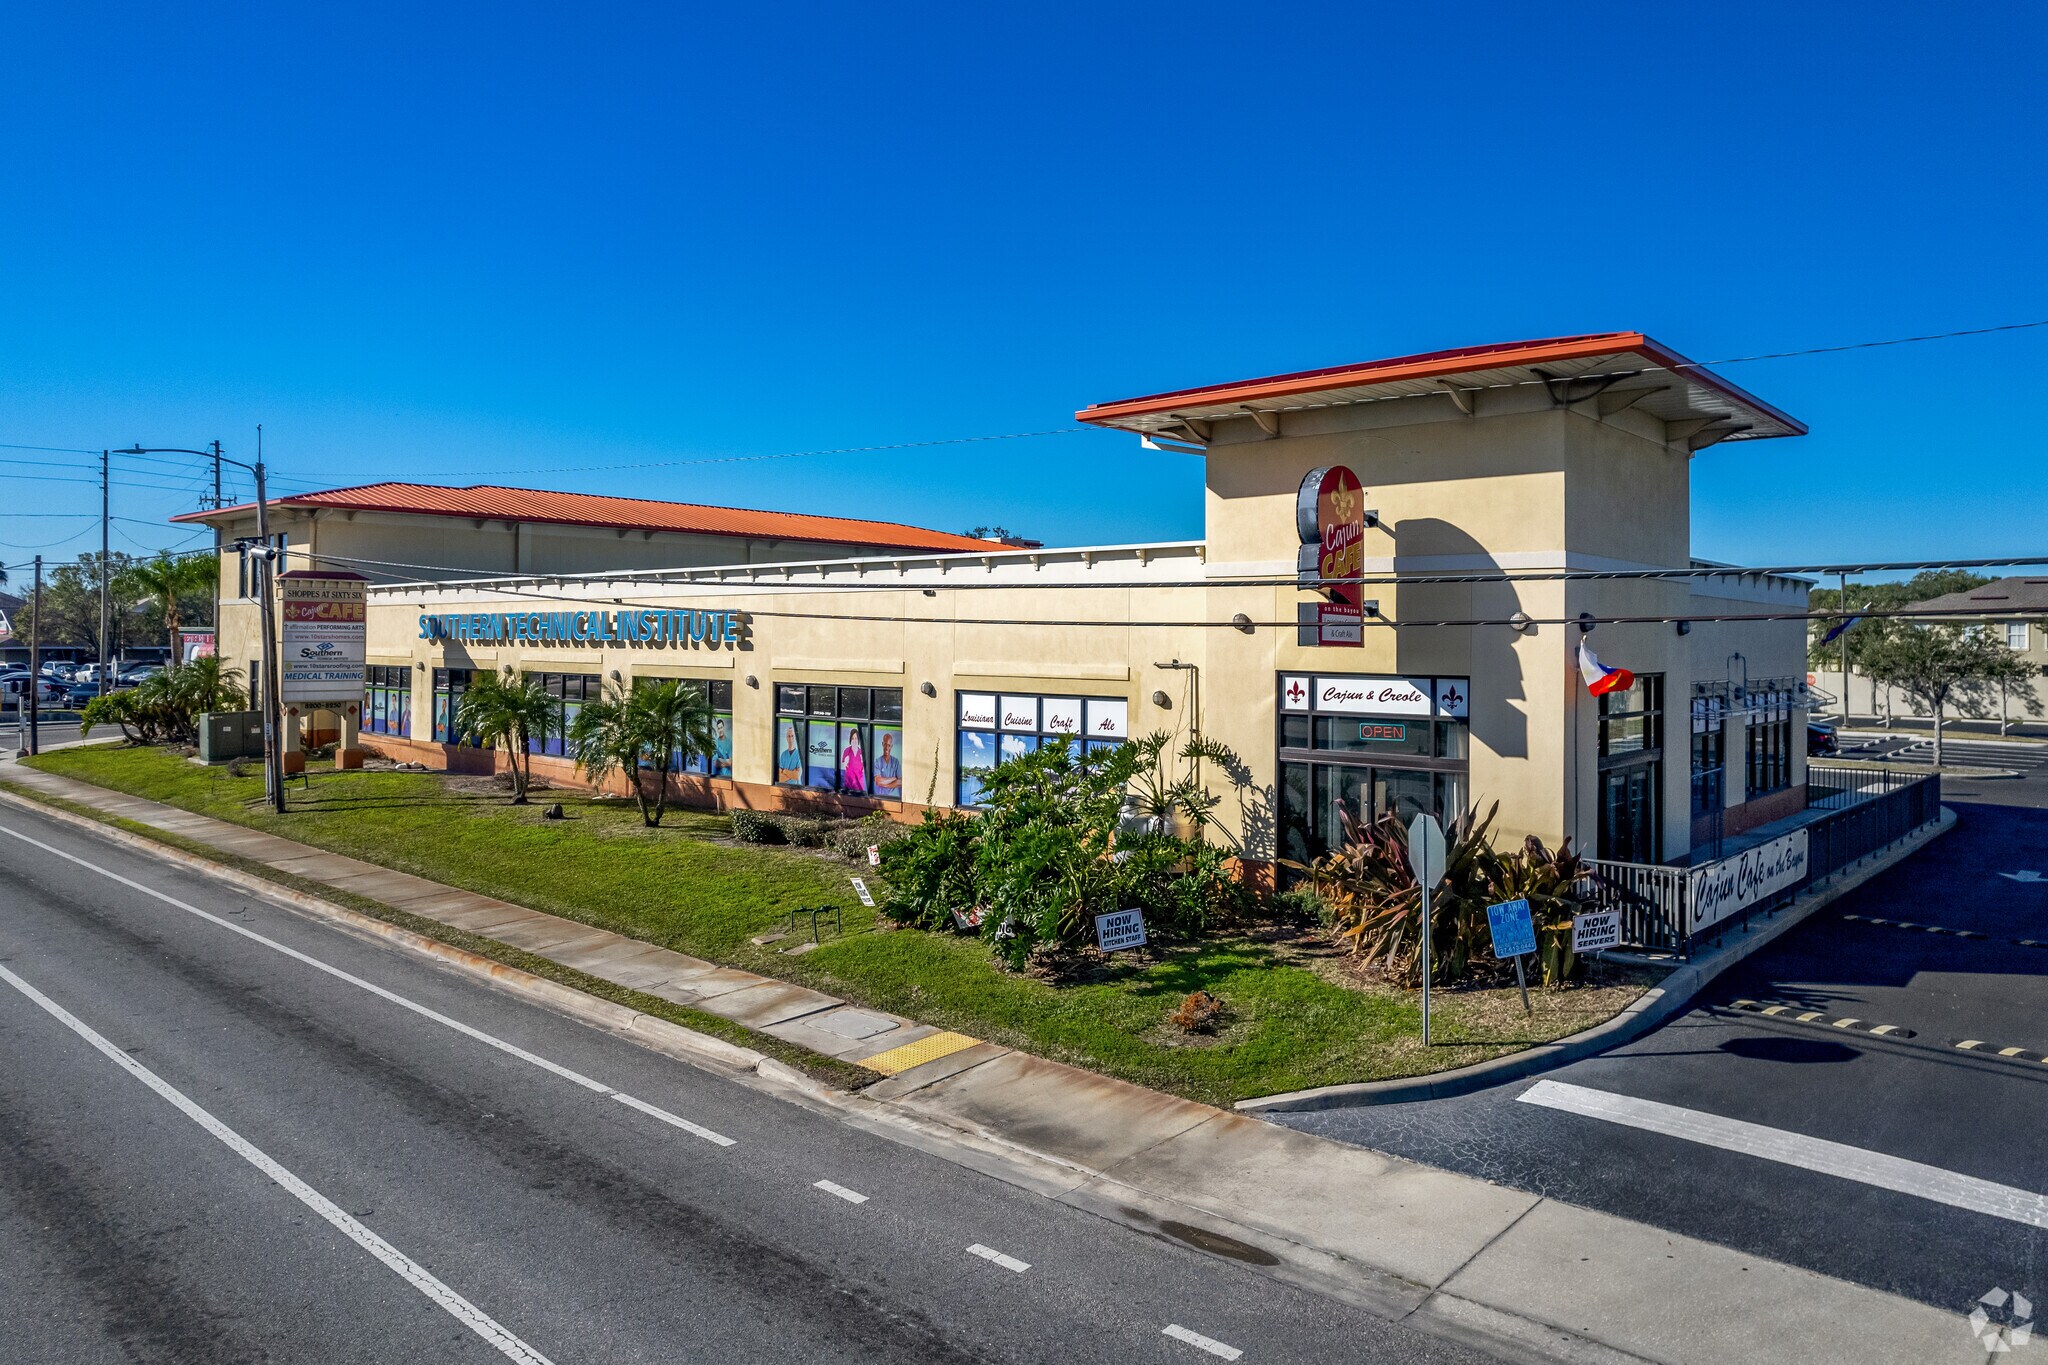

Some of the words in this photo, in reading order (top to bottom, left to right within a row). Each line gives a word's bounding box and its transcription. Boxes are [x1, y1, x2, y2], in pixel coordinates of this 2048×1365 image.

[1325, 519, 1360, 561] Cajun
[1321, 543, 1361, 580] CAFE
[318, 603, 363, 618] CAFE
[418, 613, 500, 640] SOUTHERN
[507, 610, 610, 641] TECHNICAL
[616, 609, 738, 642] INSTITUTE
[1335, 630, 1346, 638] Craft
[300, 648, 342, 658] Southern
[1323, 686, 1364, 704] Cajun
[1366, 690, 1374, 700] &
[1378, 688, 1422, 702] Creole
[962, 710, 994, 723] Louisiana
[1004, 712, 1033, 726] Cuisine
[1050, 715, 1073, 732] Craft
[1098, 718, 1115, 731] Ale
[1362, 726, 1403, 738] OPEN
[1695, 867, 1734, 922] Cajun
[1490, 906, 1504, 916] TOW
[1508, 901, 1526, 912] AWAY
[1106, 914, 1132, 928] NOW
[1501, 912, 1520, 924] ZONE
[1584, 916, 1610, 928] NOW
[1102, 924, 1139, 939] HIRING
[1577, 925, 1616, 940] HIRING
[1104, 939, 1124, 947] KITCHEN
[1126, 934, 1141, 942] STAFF
[1577, 936, 1615, 948] SERVERS
